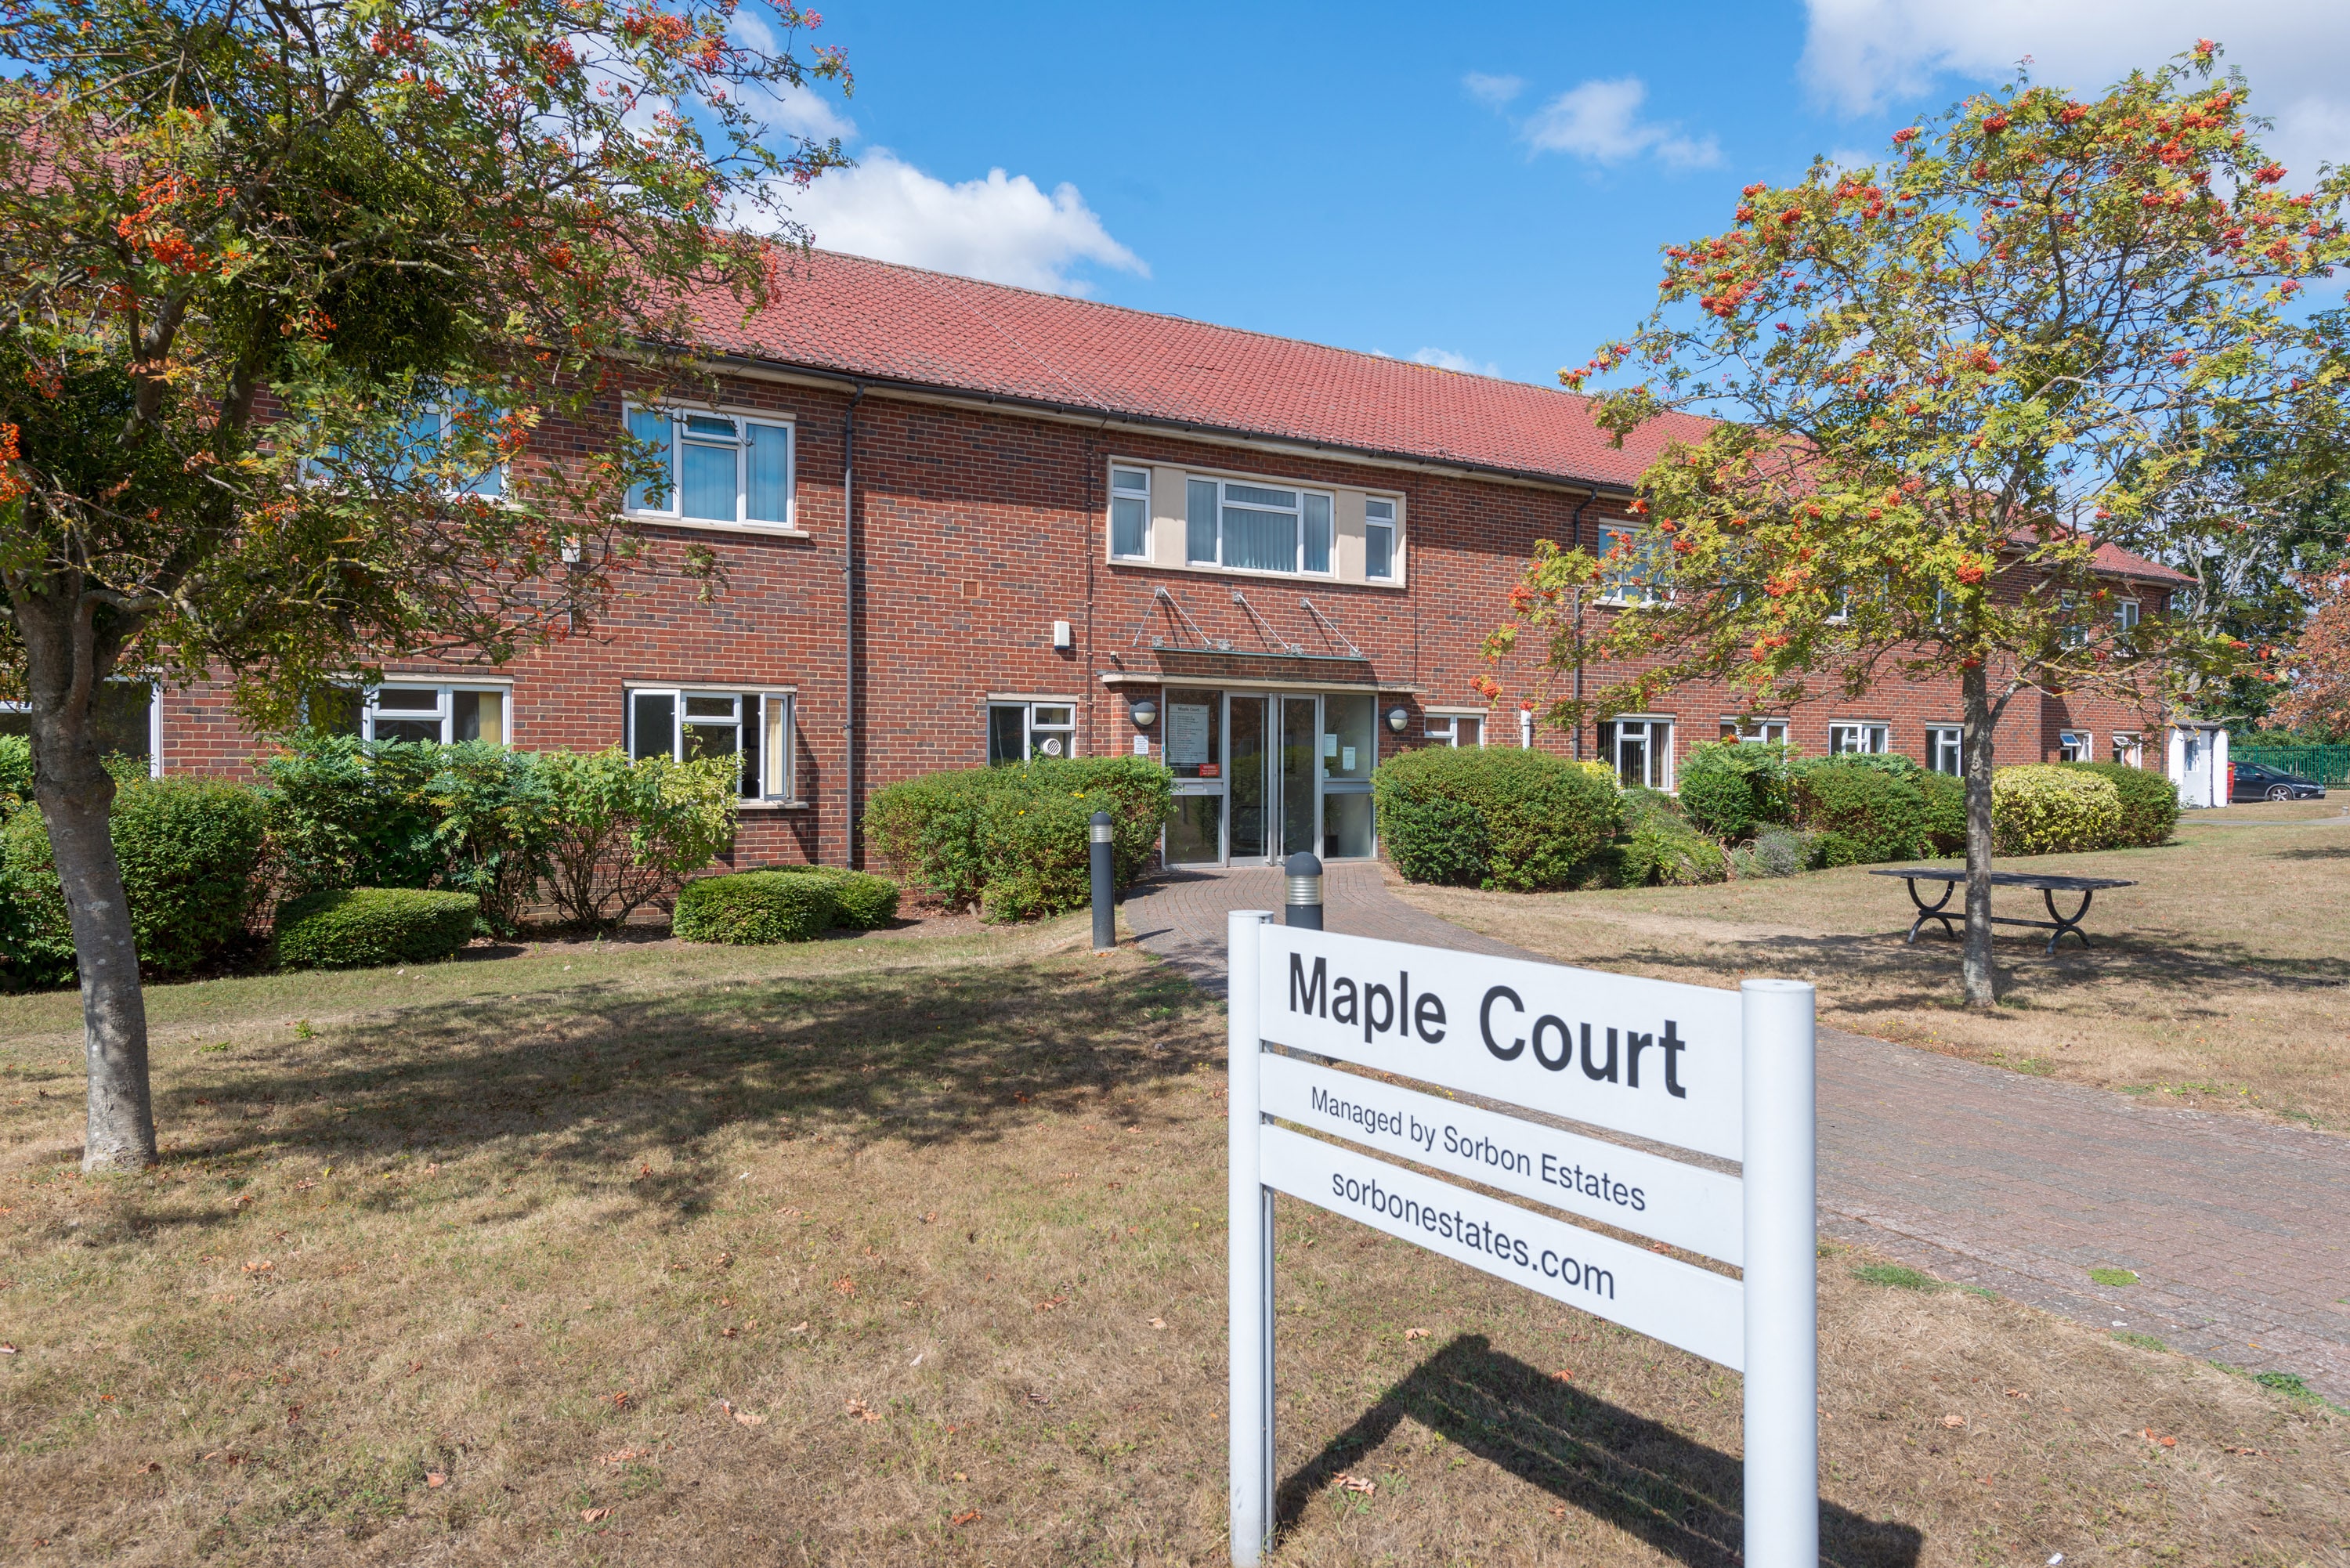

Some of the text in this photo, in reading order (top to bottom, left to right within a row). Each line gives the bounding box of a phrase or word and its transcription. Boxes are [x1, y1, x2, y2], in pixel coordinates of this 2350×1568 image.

[1289, 952, 1687, 1100] Maple Court
[1312, 1086, 1646, 1211] Managed by Sorbon Estates
[1332, 1173, 1614, 1300] sorbonestates.com
